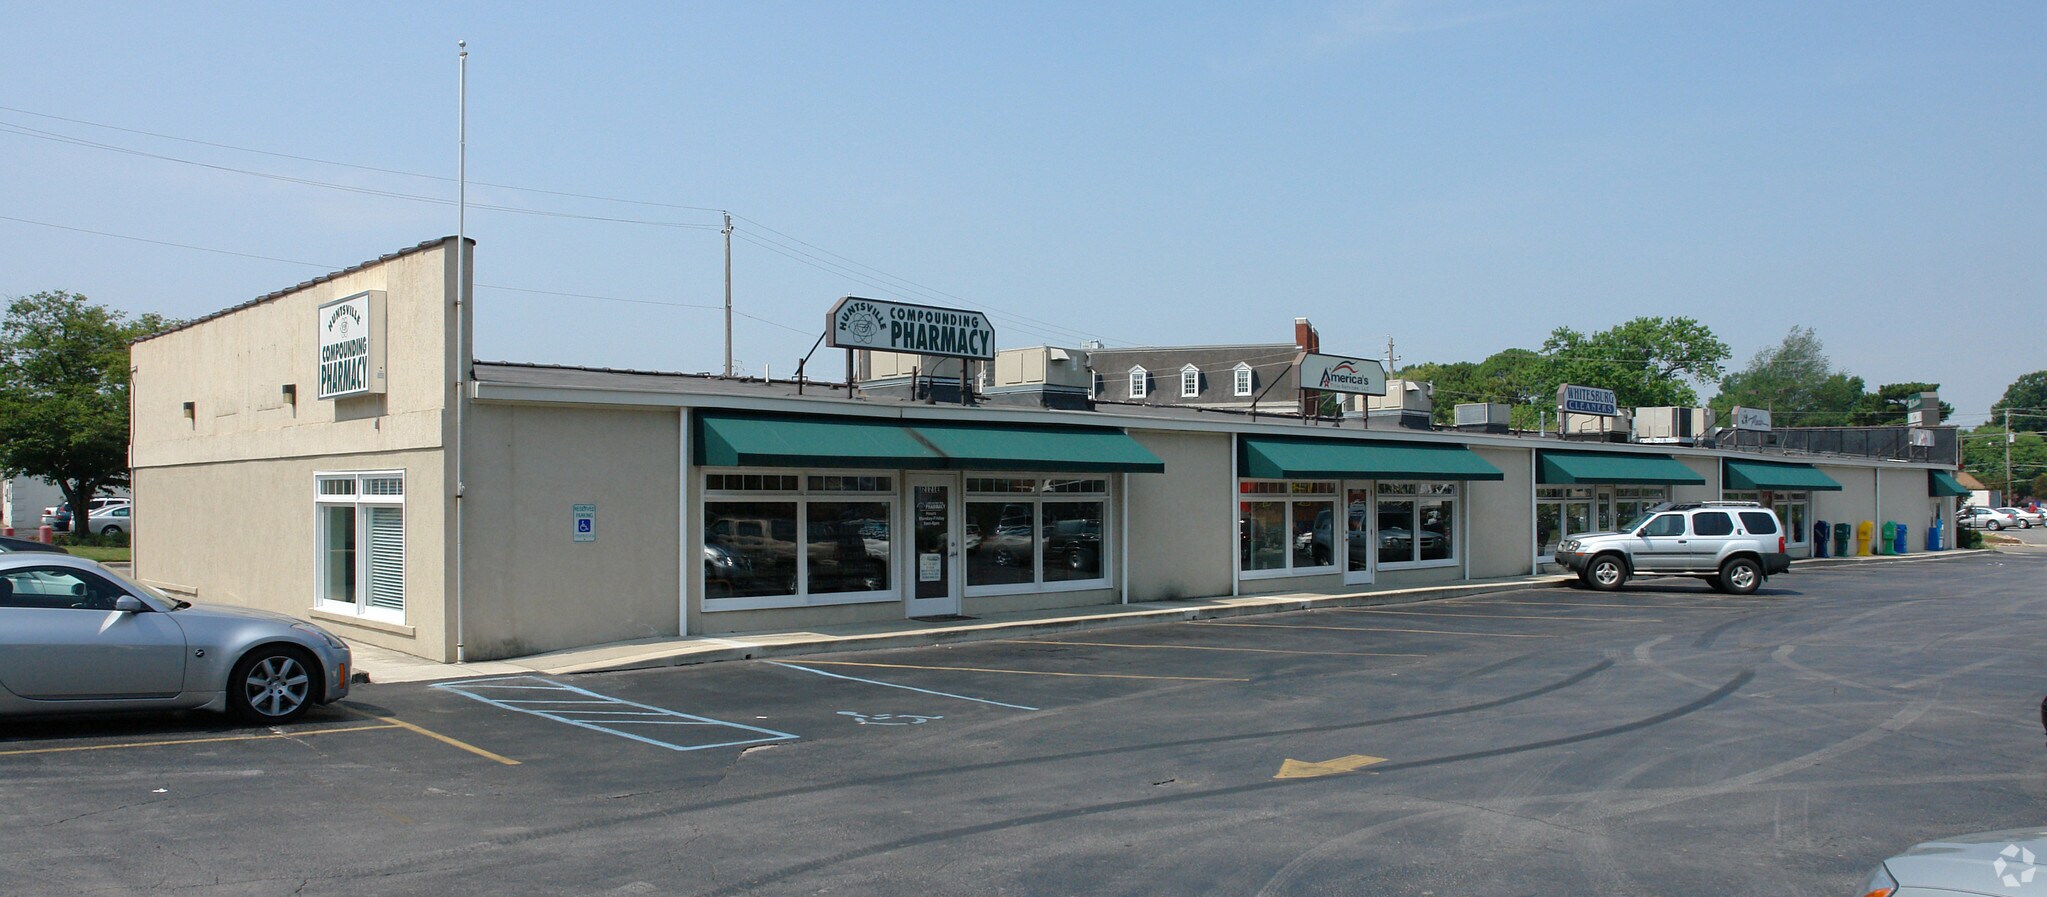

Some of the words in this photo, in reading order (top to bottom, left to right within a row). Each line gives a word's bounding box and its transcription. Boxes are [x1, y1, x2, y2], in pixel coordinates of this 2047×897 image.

[328, 304, 361, 332] HUNTSVILLE
[839, 302, 887, 331] HUNTSVILLE
[890, 307, 979, 328] COMPOUNDING
[322, 336, 367, 363] COMPOUNDING
[890, 320, 990, 356] PHARMACY
[321, 355, 368, 395] PHARMACY
[1319, 367, 1369, 387] America's
[1567, 387, 1614, 404] WHITESBURG
[1569, 401, 1612, 413] CLEANERS
